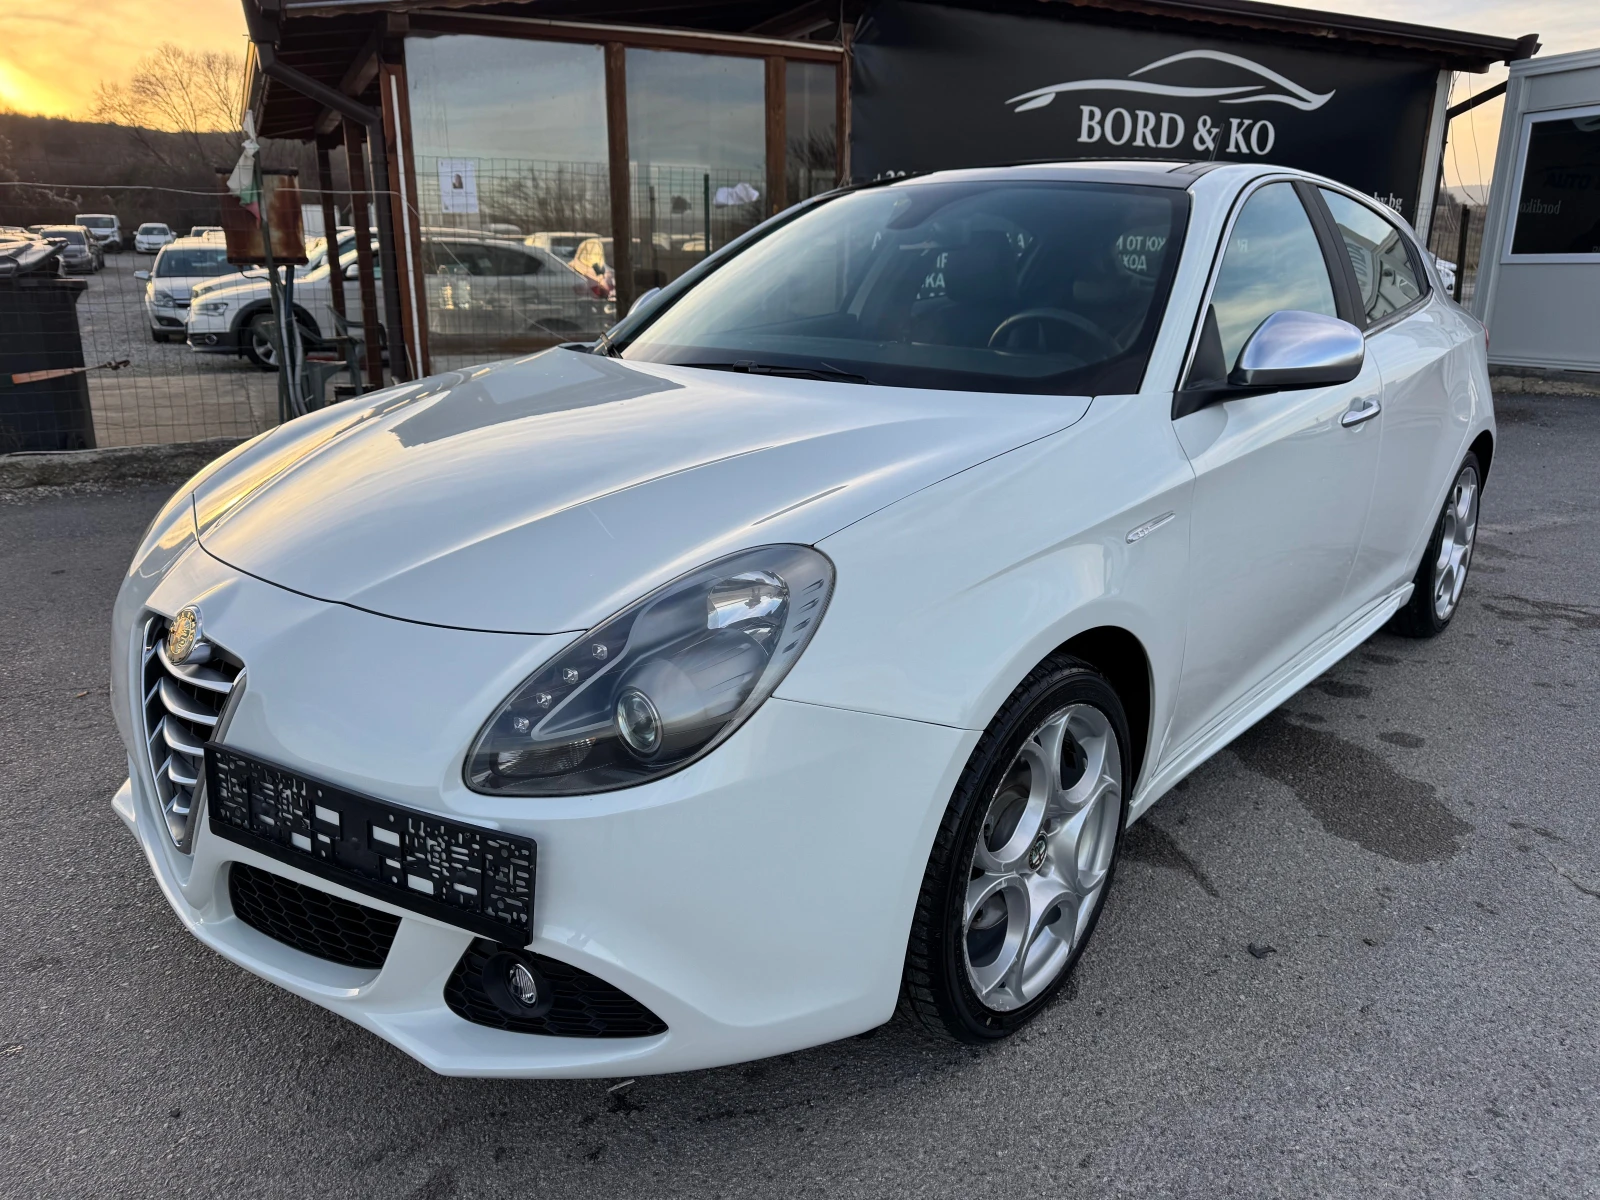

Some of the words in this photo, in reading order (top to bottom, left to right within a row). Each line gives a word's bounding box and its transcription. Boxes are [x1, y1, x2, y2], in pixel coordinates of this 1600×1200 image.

[1077, 105, 1185, 149] BORD
[1193, 115, 1220, 151] &
[1226, 117, 1275, 156] KO
